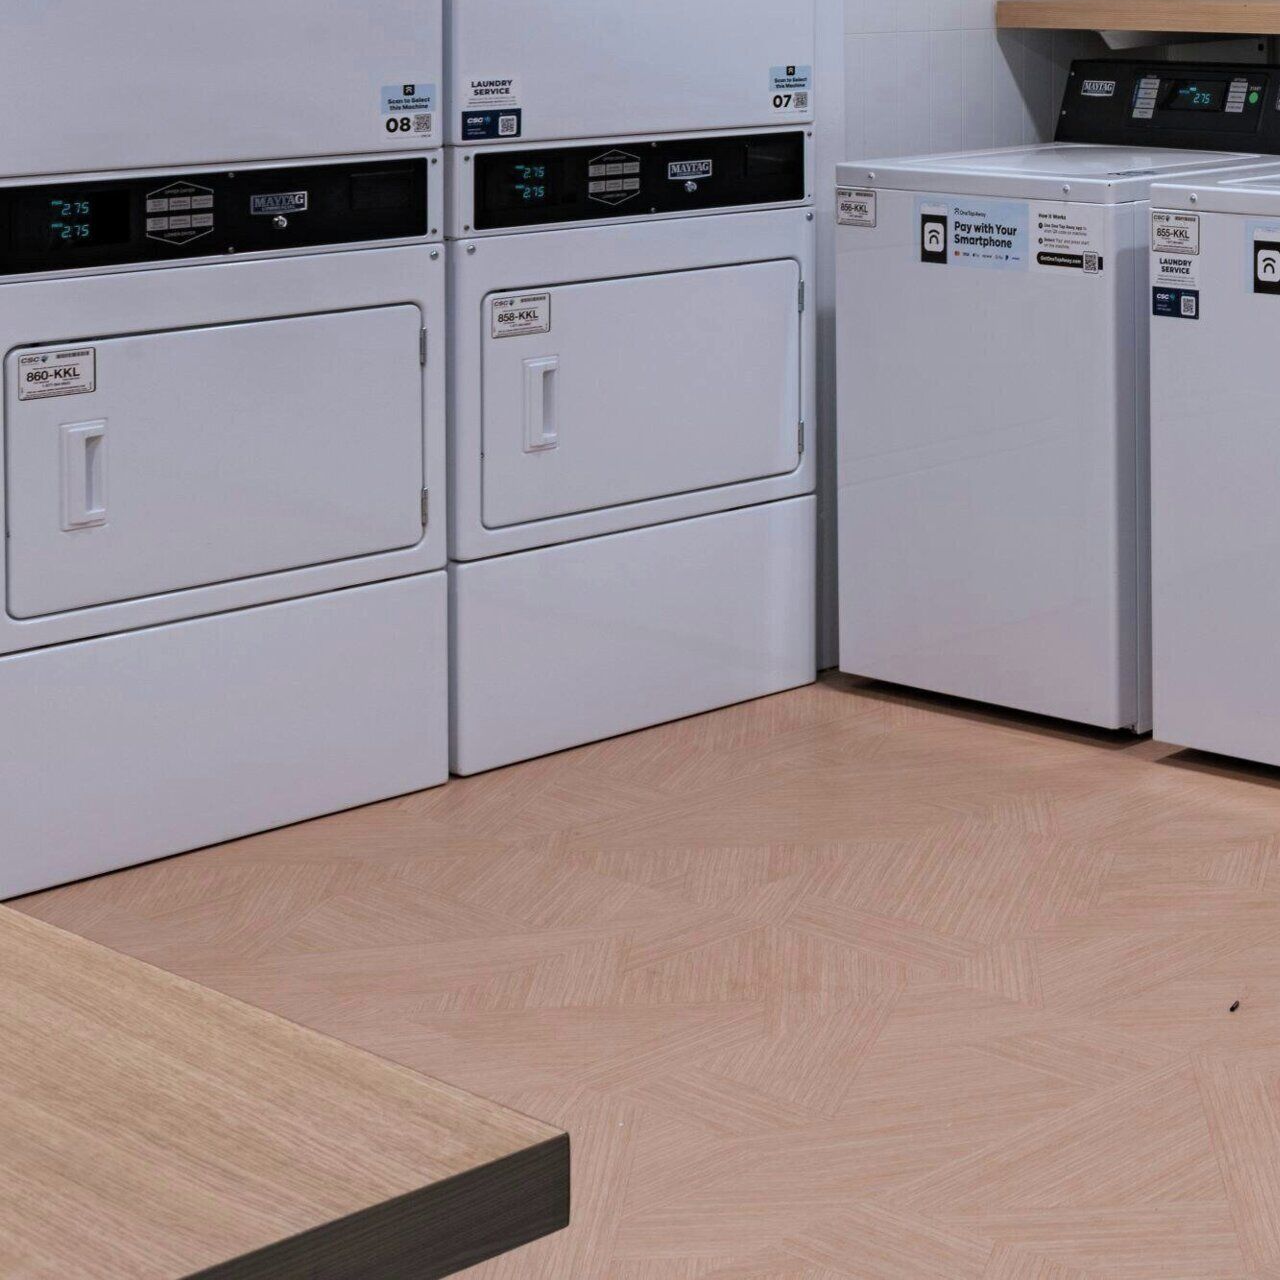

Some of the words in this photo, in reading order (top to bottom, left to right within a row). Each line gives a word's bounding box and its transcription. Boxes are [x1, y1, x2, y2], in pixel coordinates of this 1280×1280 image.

[471, 79, 513, 88] LAUNDRY
[1084, 82, 1114, 91] MAYTAG
[473, 87, 510, 96] SERVICE
[773, 94, 792, 108] 07
[386, 117, 411, 133] 08
[671, 161, 710, 173] MAYTAG
[254, 193, 304, 208] MAYTAG
[61, 202, 89, 216] 2.75
[61, 224, 89, 238] 2.75
[954, 221, 972, 234] Pay
[974, 223, 994, 234] with
[995, 224, 1017, 236] Your
[1156, 227, 1190, 239] 855-KKL
[954, 234, 1013, 248] Smartphone
[1159, 258, 1192, 267] LAUNDRY
[1161, 265, 1190, 274] SERVICE
[498, 310, 539, 323] 858-KKL
[26, 367, 80, 382] 860-KKL
